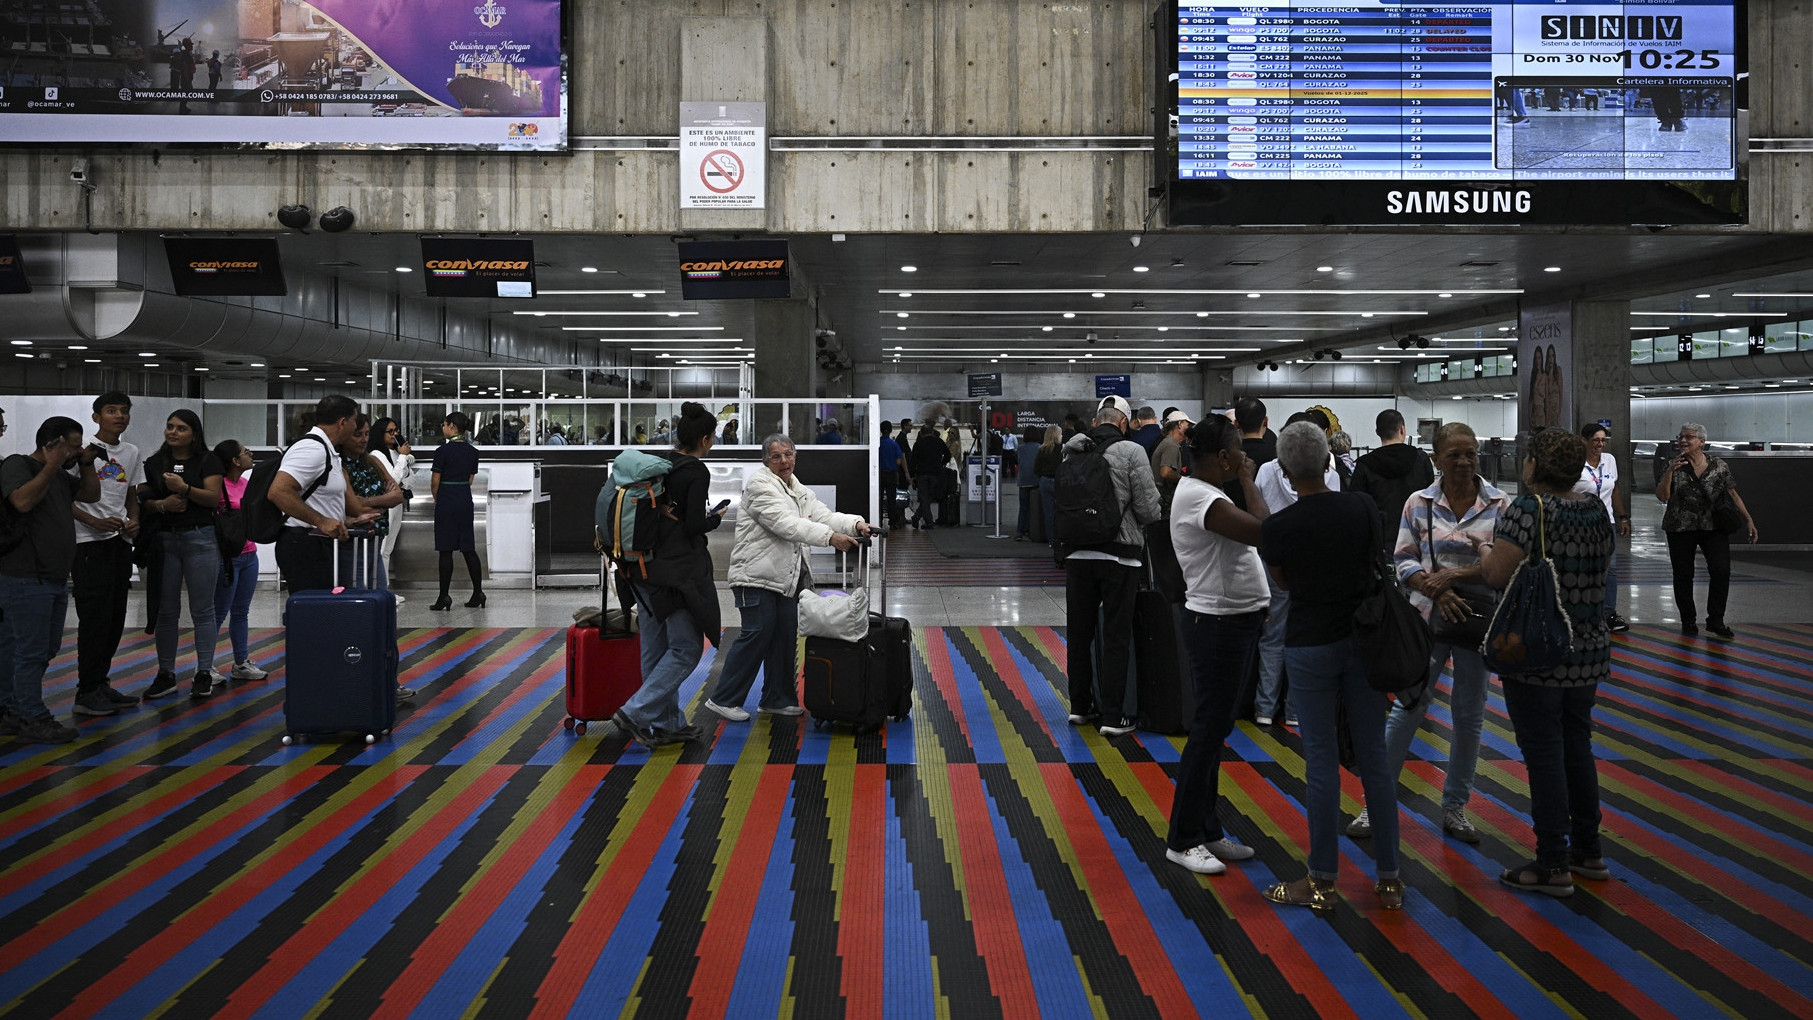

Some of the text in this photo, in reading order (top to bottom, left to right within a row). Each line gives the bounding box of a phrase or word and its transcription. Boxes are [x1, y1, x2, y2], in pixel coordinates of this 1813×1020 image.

[1545, 17, 1679, 37] SINIV
[450, 40, 484, 50] Soluciones
[499, 40, 530, 52] Navegan
[496, 54, 506, 63] del
[506, 53, 526, 63] Mar
[1524, 55, 1622, 63] Dom 30 Nov
[1616, 50, 1720, 69] 10:25
[1541, 170, 1581, 179] airport
[1387, 190, 1531, 213] SAMSUNG
[426, 258, 529, 270] conviasa
[680, 259, 785, 271] conviasa
